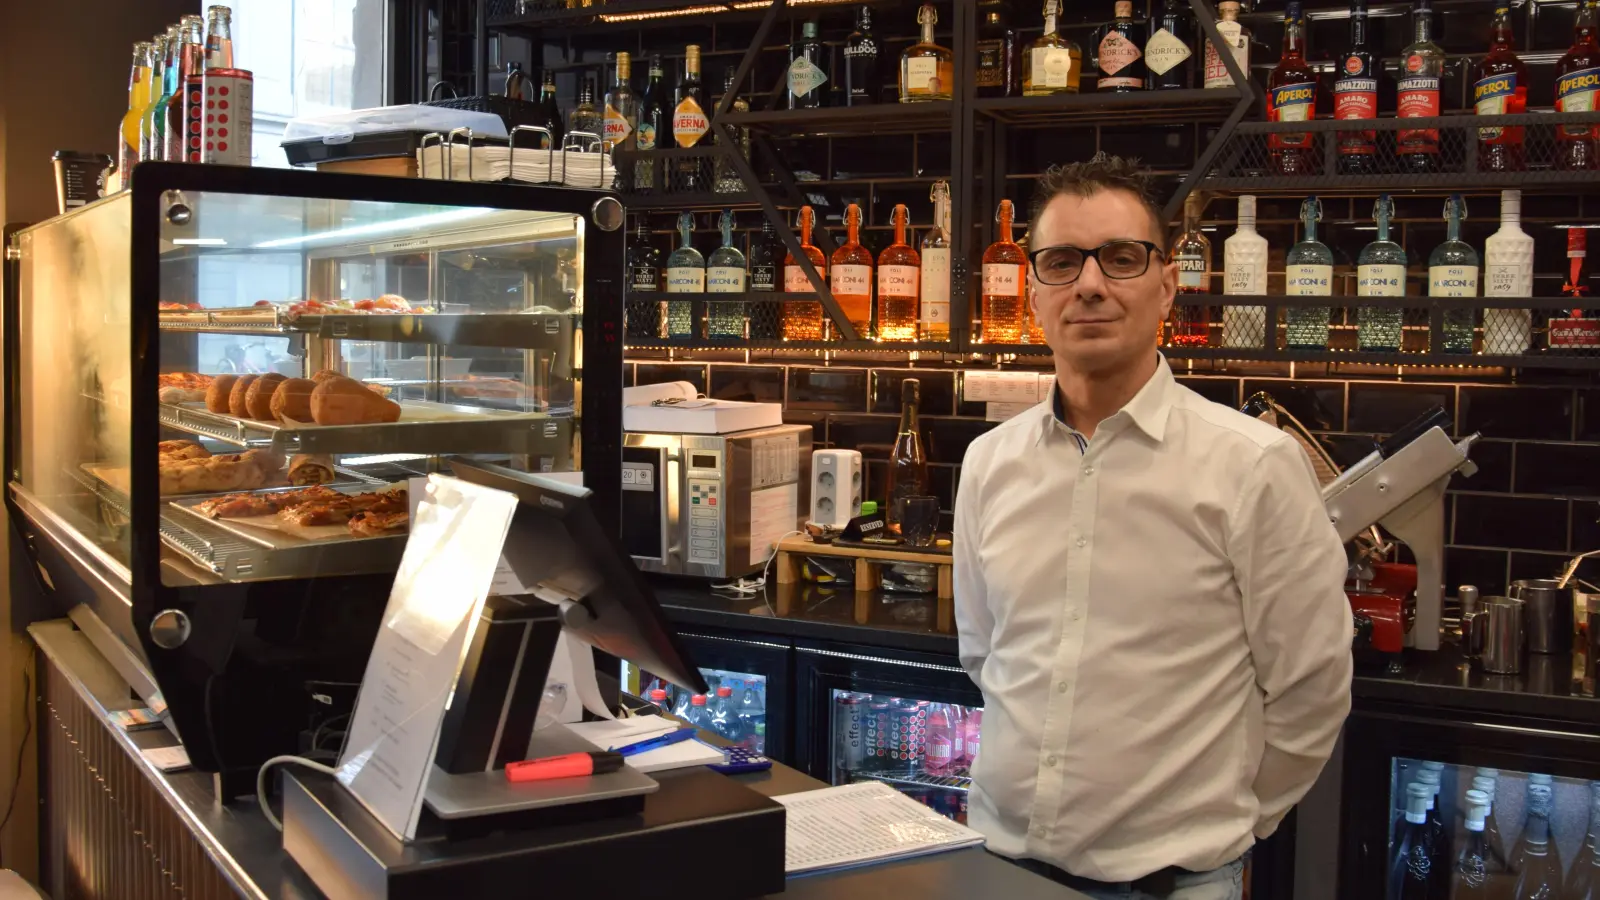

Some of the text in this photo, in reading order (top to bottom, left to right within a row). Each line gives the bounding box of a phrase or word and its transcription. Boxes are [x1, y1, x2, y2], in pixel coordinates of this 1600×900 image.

[844, 46, 878, 56] BULLDOG
[1475, 80, 1511, 100] APEROL
[1559, 75, 1599, 96] APEROL
[1276, 89, 1312, 105] APEROL
[1340, 96, 1369, 105] AMARO
[1401, 94, 1430, 104] AMARO
[1177, 260, 1205, 271] MPARI
[849, 705, 859, 748] effect
[866, 713, 876, 756] effect
[890, 716, 899, 759] effect
